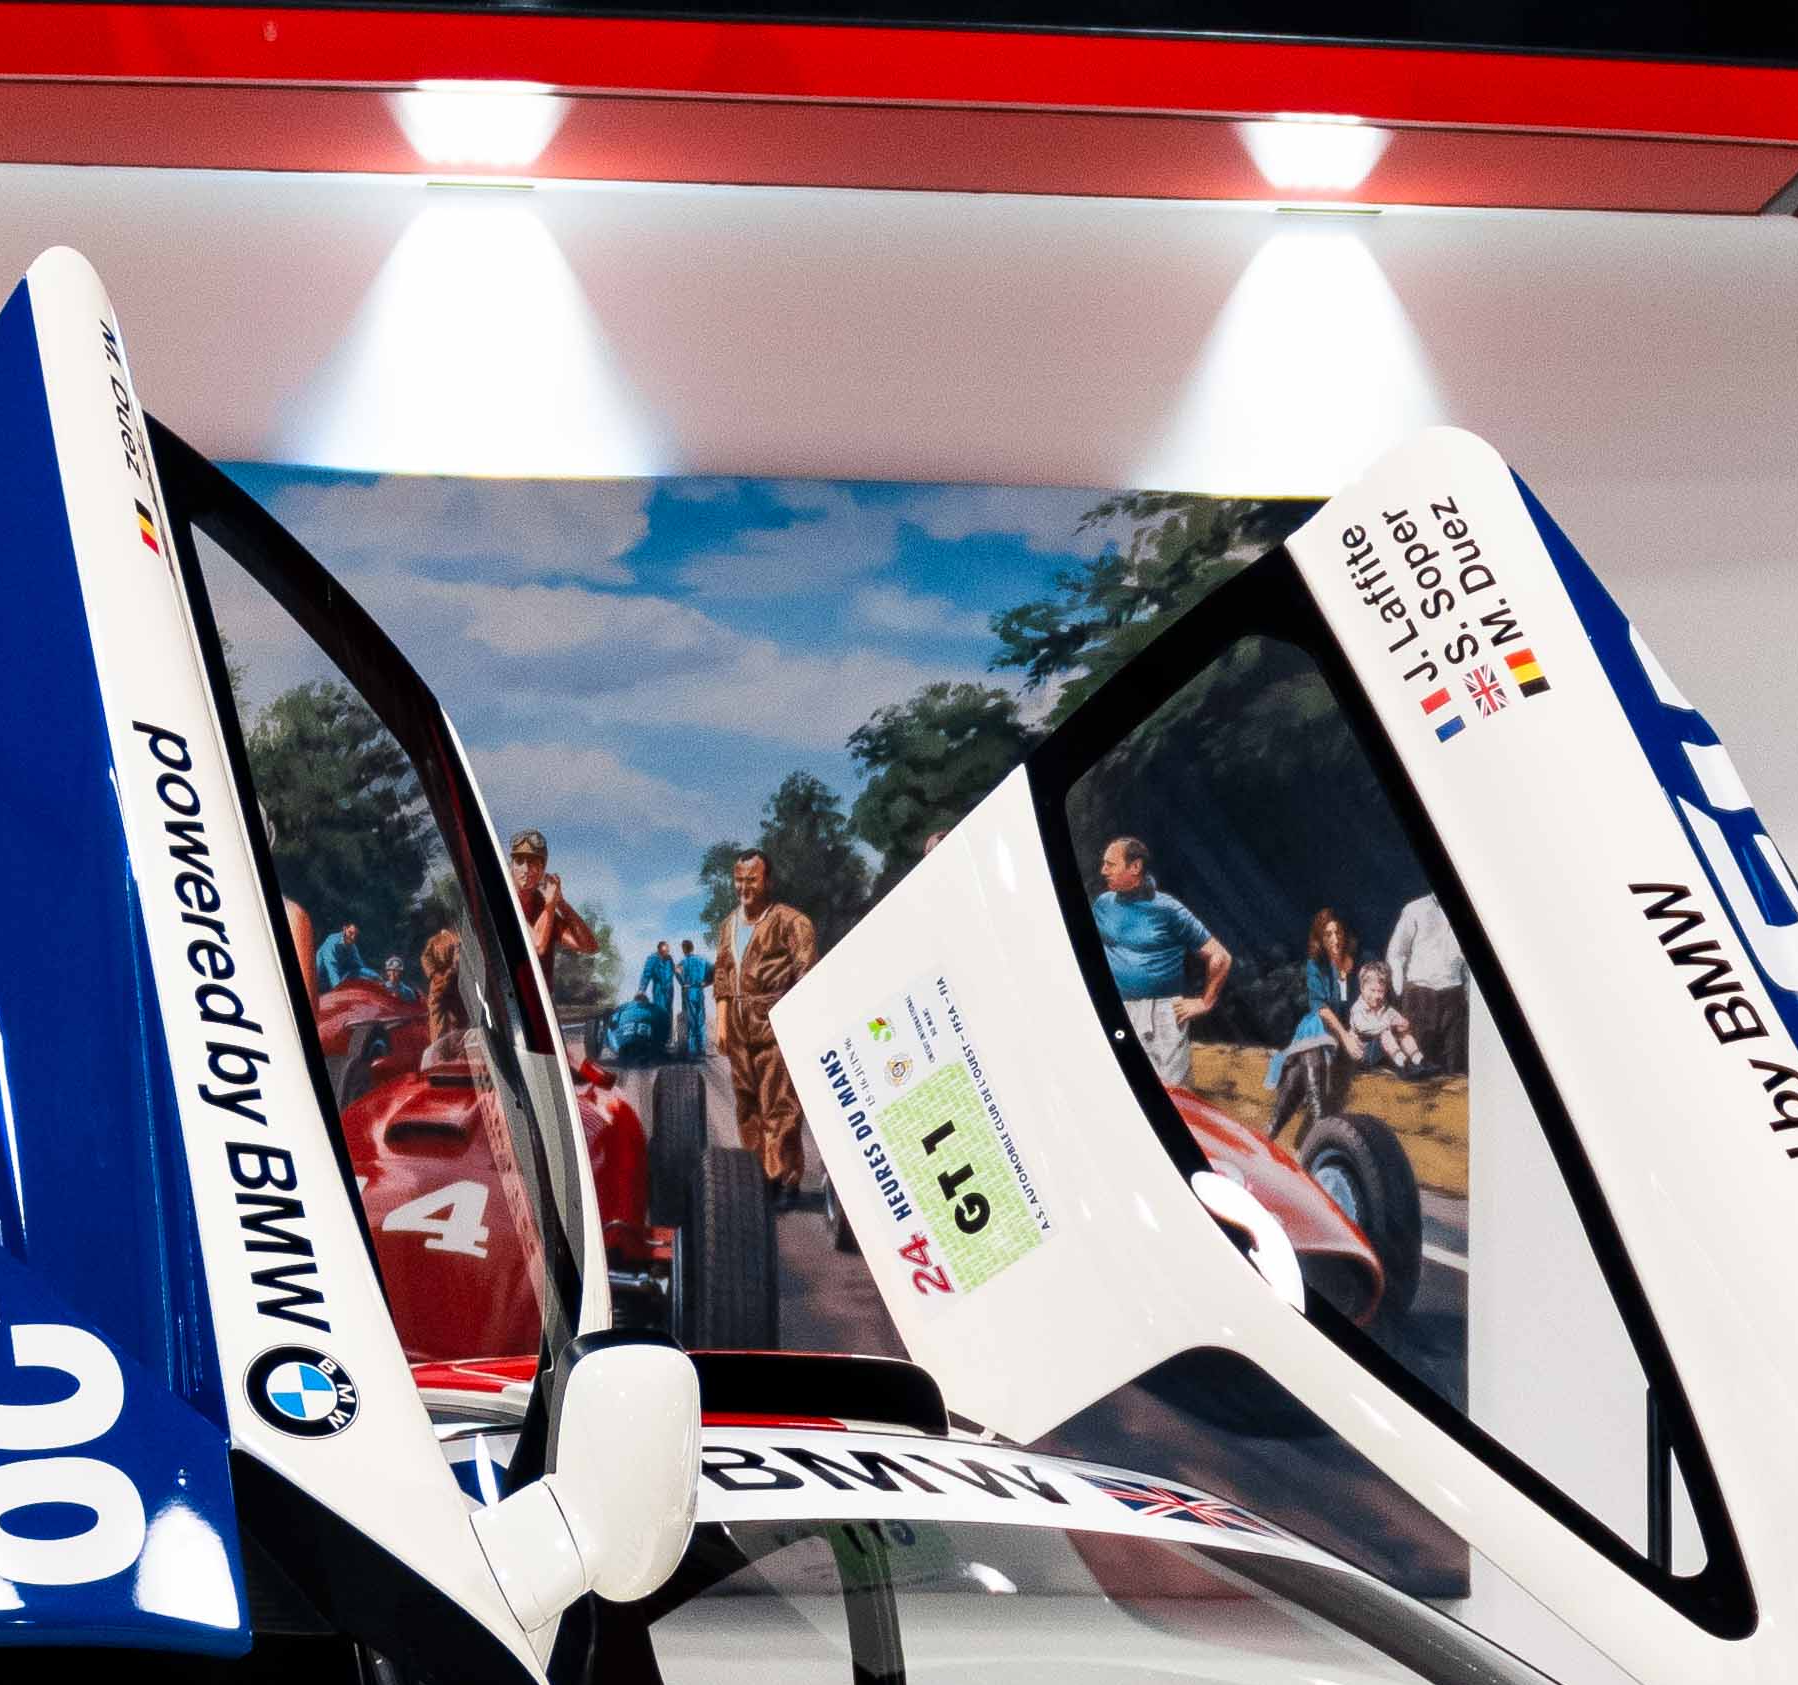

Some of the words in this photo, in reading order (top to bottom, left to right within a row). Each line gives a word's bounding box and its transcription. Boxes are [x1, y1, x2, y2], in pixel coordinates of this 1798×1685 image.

[100, 319, 122, 368] M.
[109, 374, 142, 480] Duez
[1382, 509, 1455, 620] Soper
[1430, 496, 1497, 596] Duez
[1342, 524, 1419, 654] Laffitte
[1444, 621, 1480, 665] S.
[1479, 597, 1524, 648] M.
[1403, 649, 1439, 683] J.
[132, 720, 263, 1036] powered
[936, 976, 948, 997] FIA
[1627, 882, 1770, 1046] BMW
[947, 1005, 964, 1033] FFSA
[198, 1041, 271, 1126] by
[820, 1049, 859, 1108] MANS
[962, 1043, 986, 1088] L'OUEST
[980, 1087, 993, 1104] DE
[847, 1110, 873, 1142] DU
[921, 1119, 956, 1156] 1
[988, 1103, 1005, 1131] CLUB
[863, 1142, 913, 1223] HEURES
[937, 1162, 991, 1235] GT
[1000, 1131, 1039, 1205] AUTOMOBILE
[223, 1140, 332, 1334] BMW
[1035, 1206, 1051, 1231] A.S.
[898, 1232, 956, 1297] 24
[317, 1356, 355, 1433] BMW
[702, 1445, 1072, 1506] BMW
